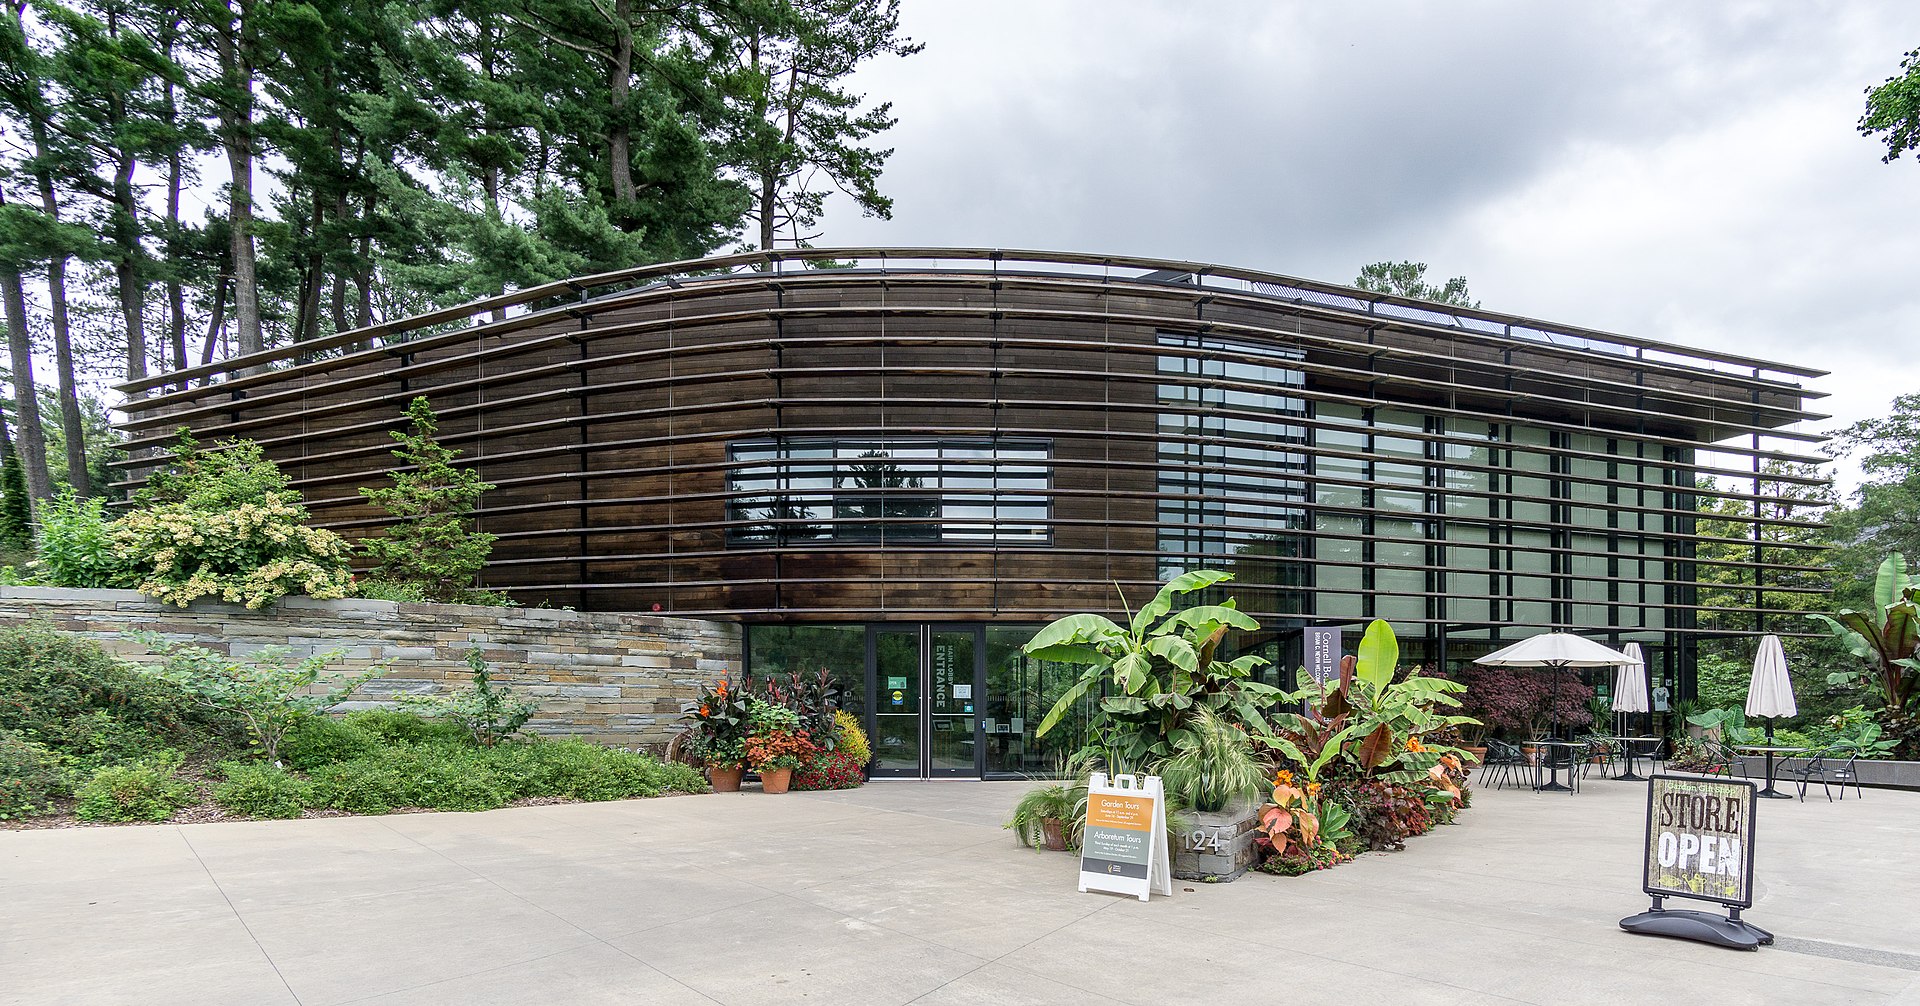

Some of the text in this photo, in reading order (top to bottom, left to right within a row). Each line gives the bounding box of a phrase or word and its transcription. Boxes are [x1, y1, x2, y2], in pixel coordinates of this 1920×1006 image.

[1322, 632, 1332, 664] Cornell
[936, 645, 946, 708] ENTRANCE
[1667, 782, 1736, 795] Garden Gift Shop
[1101, 799, 1140, 810] Garden Tours
[1660, 792, 1740, 834] STORE
[1093, 830, 1142, 844] Arboretum Tours
[1182, 830, 1221, 852] 124
[1657, 831, 1740, 876] OPEN
